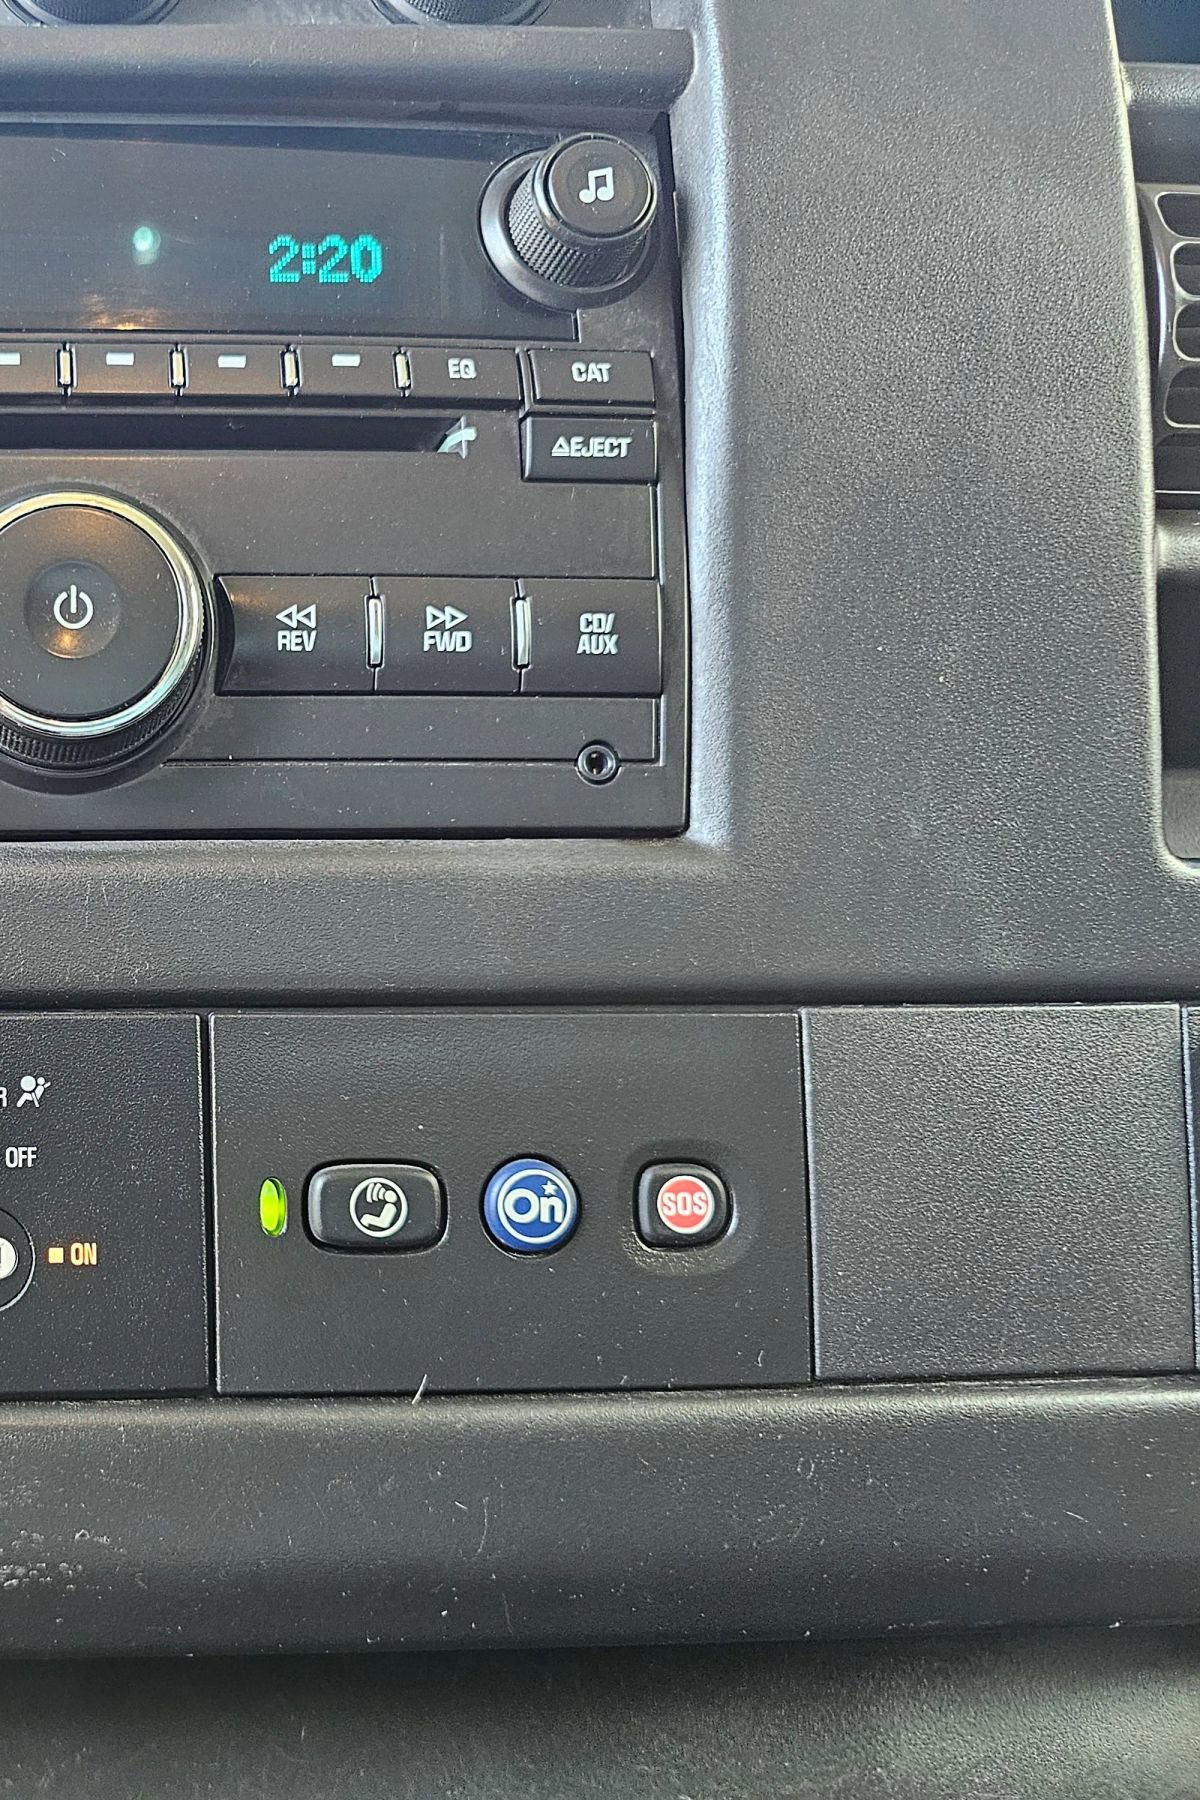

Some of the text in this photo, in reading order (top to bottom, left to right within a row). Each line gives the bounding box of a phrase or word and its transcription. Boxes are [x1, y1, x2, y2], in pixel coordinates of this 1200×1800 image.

[268, 233, 383, 284] 2:20
[447, 358, 477, 381] EQ
[571, 361, 612, 384] CAT
[570, 436, 632, 457] EJECT
[579, 612, 615, 633] CD/
[276, 629, 318, 653] REV
[422, 629, 473, 653] FWD
[576, 633, 619, 656] AUX
[5, 1146, 37, 1168] OFF
[503, 1188, 564, 1224] On
[661, 1191, 709, 1216] SOS
[70, 1242, 98, 1266] ON
